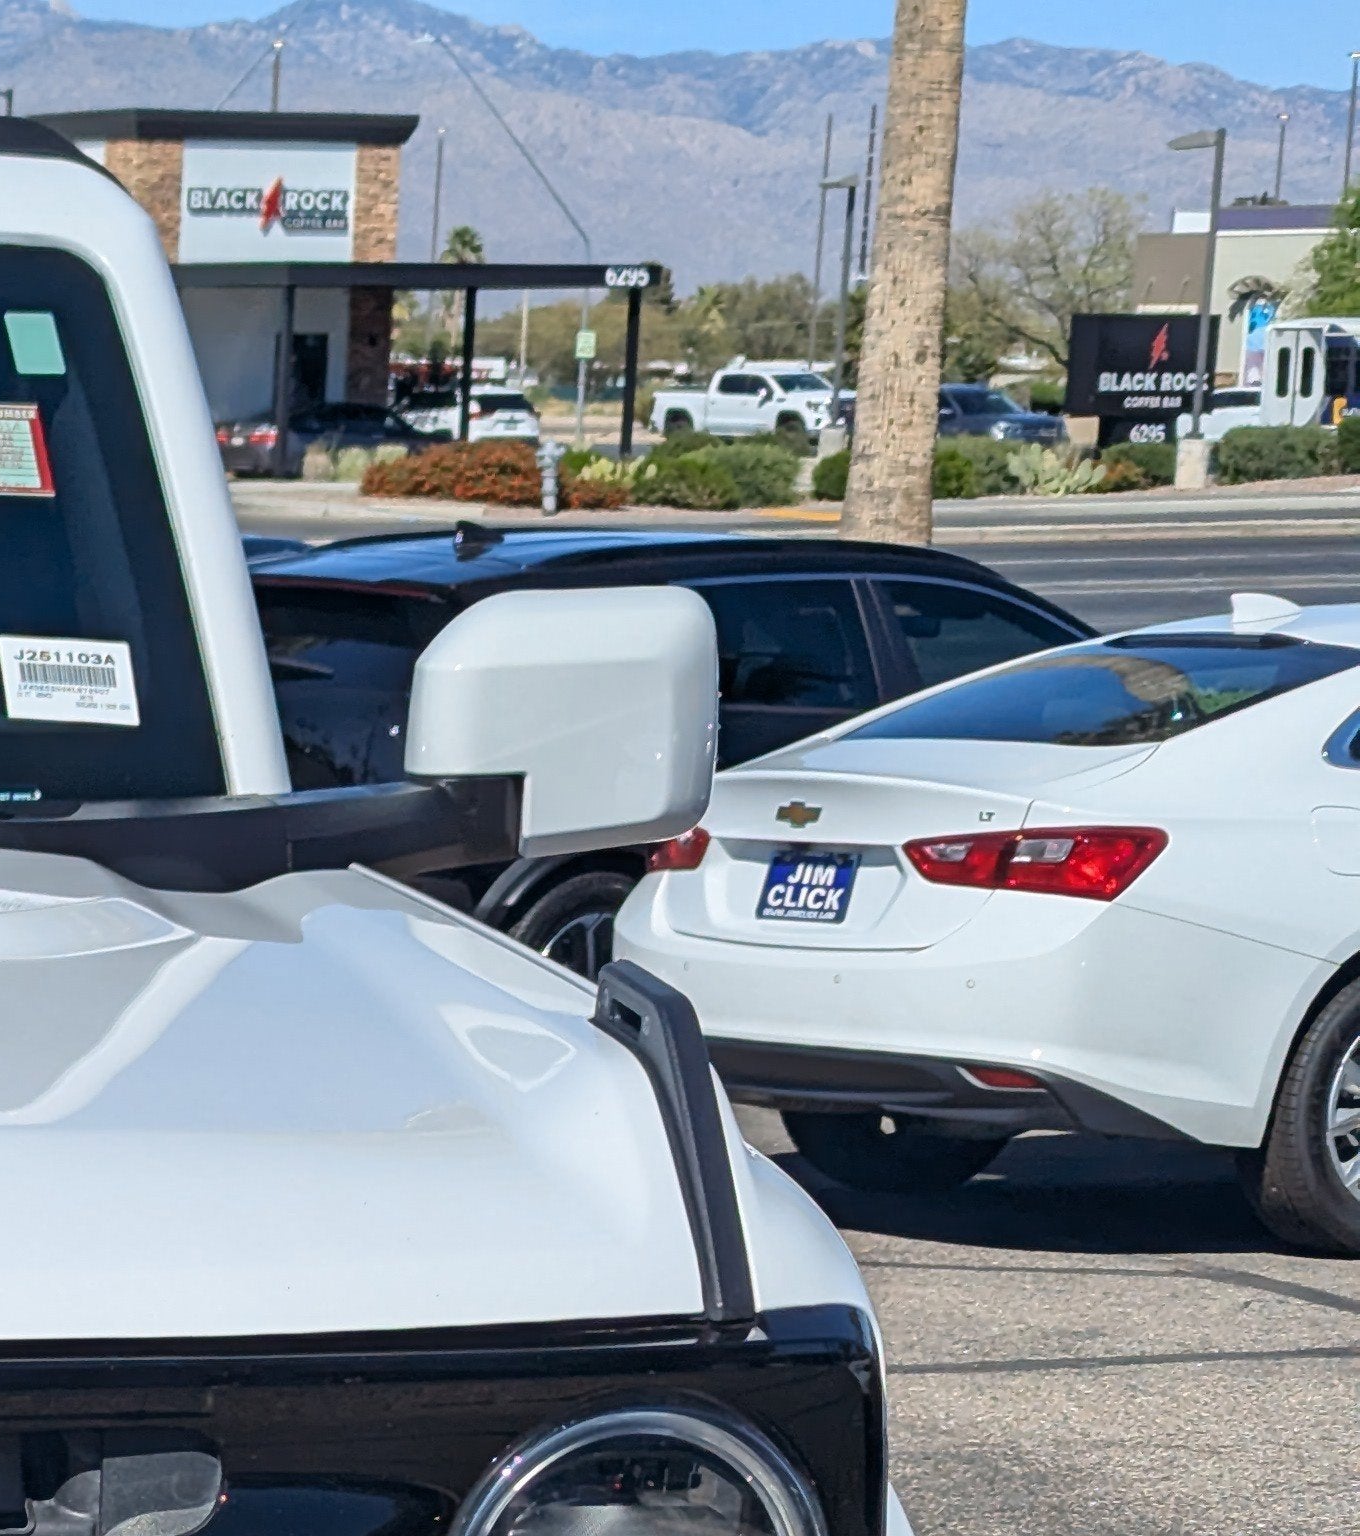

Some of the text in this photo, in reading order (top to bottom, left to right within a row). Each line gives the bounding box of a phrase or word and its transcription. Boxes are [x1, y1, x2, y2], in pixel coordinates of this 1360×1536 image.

[189, 189, 346, 212] BLACK ROCK
[605, 267, 651, 288] 6295
[1098, 372, 1158, 392] BLACK
[1130, 423, 1166, 443] 6295
[14, 650, 116, 665] J251103A
[979, 811, 996, 822] LT
[787, 861, 837, 887] JIM
[767, 883, 846, 911] CLICK
